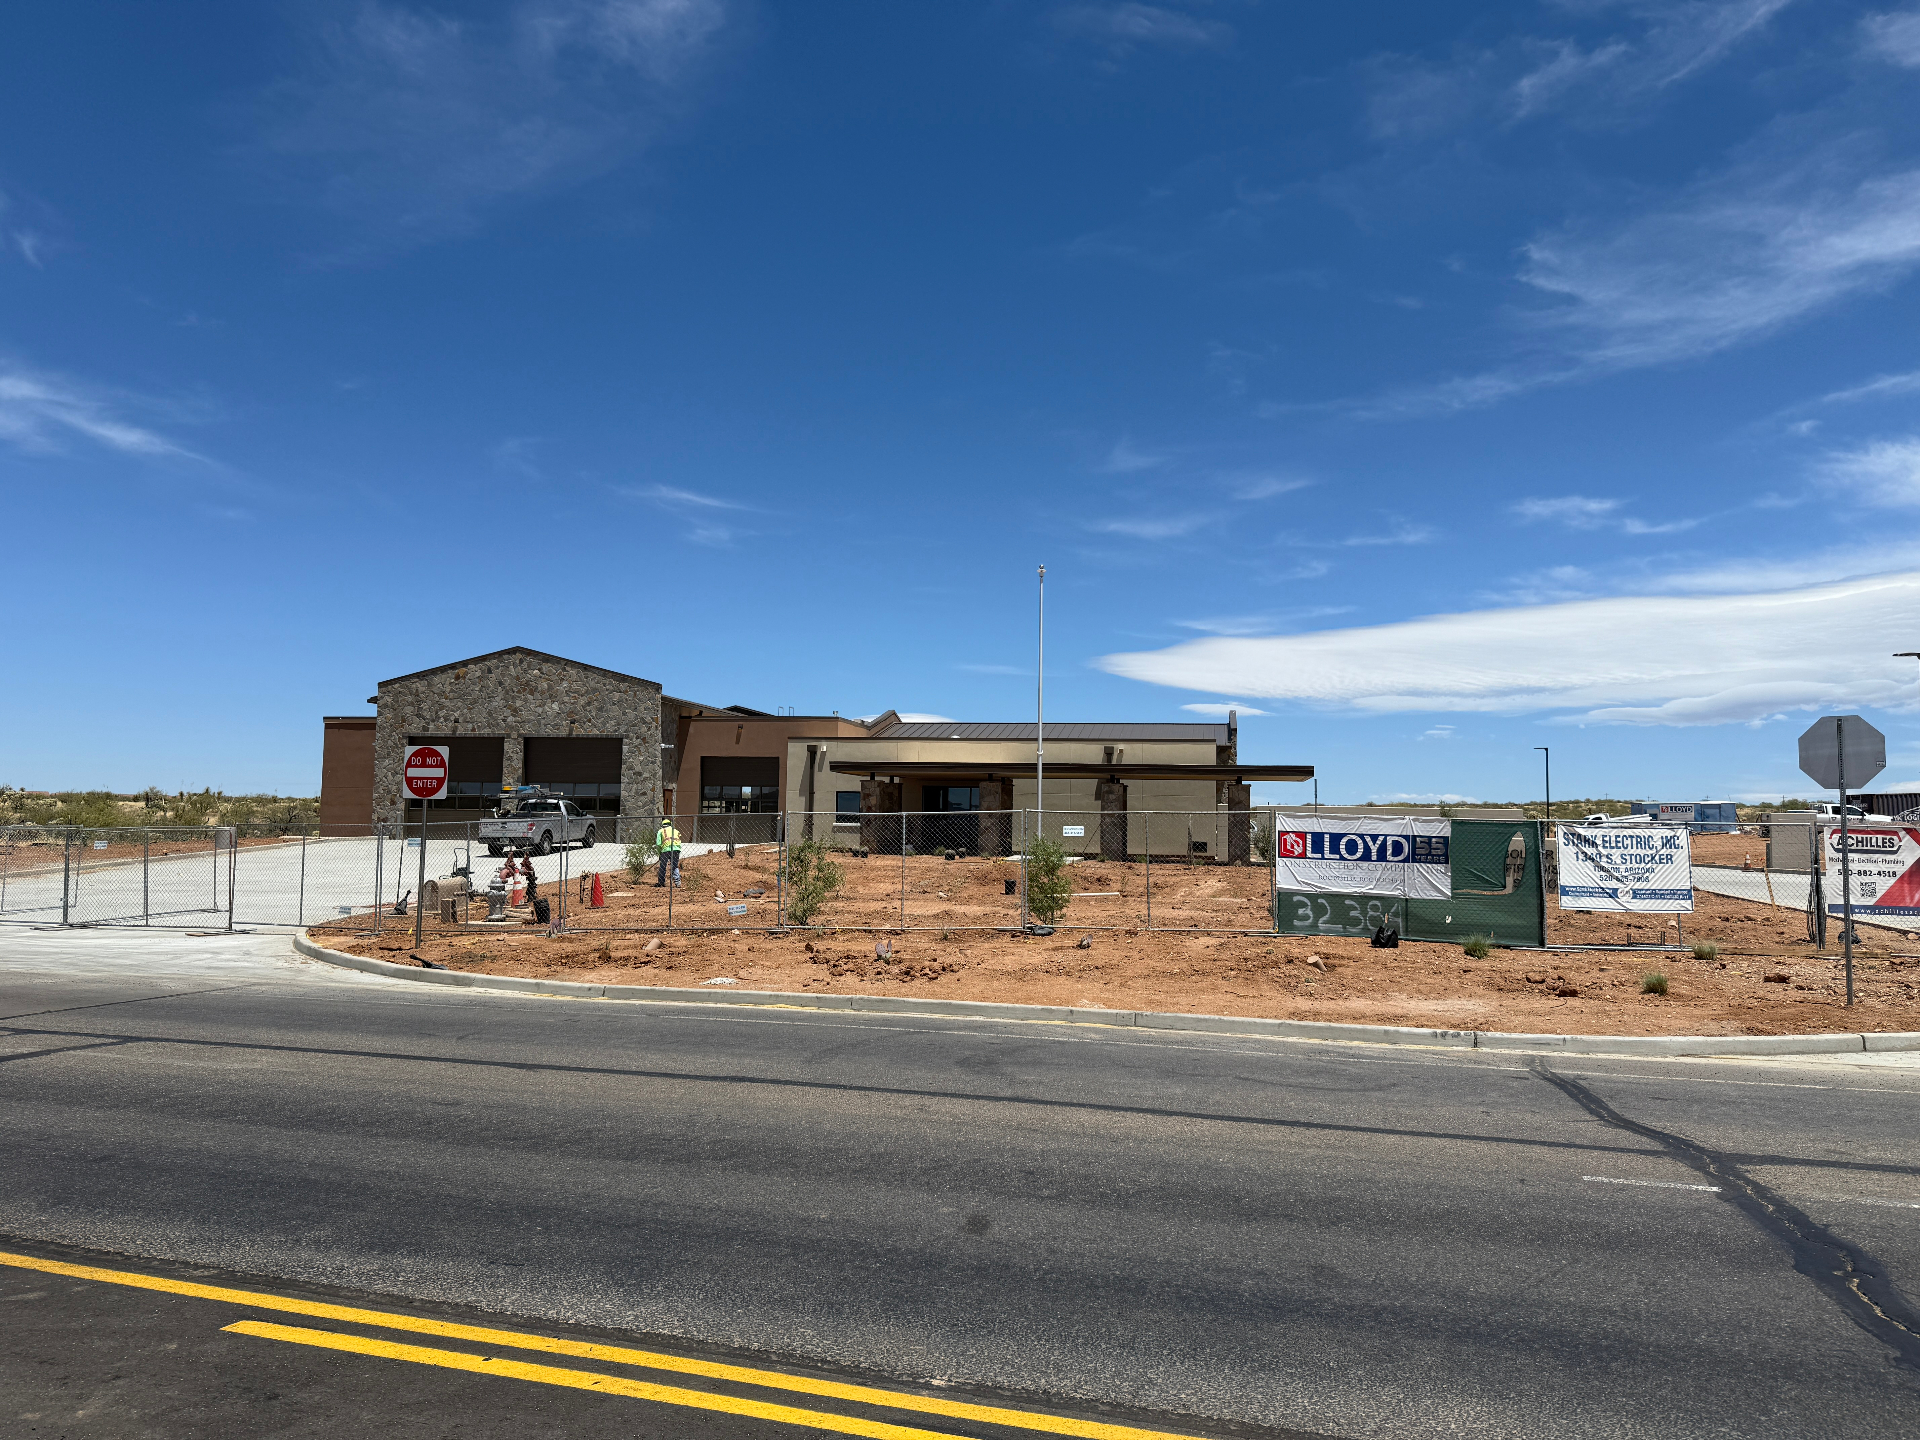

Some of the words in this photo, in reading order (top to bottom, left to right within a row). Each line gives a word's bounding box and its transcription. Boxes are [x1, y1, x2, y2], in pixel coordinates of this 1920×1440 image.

[411, 756, 422, 765] DO
[426, 756, 442, 765] NOT
[412, 779, 438, 788] ENTER
[1668, 806, 1693, 814] LLOYD
[1562, 832, 1599, 849] STARK
[1601, 834, 1658, 850] ELECTRIC,
[1661, 835, 1684, 850] INC.
[1306, 833, 1409, 861] LLOYD
[1415, 837, 1446, 855] 55
[1415, 855, 1446, 863] YEARS
[1606, 853, 1617, 864] S.
[1620, 853, 1674, 865] STOCKER
[1624, 866, 1655, 874] ARIZONA
[1837, 868, 1897, 878] 50-882-4518
